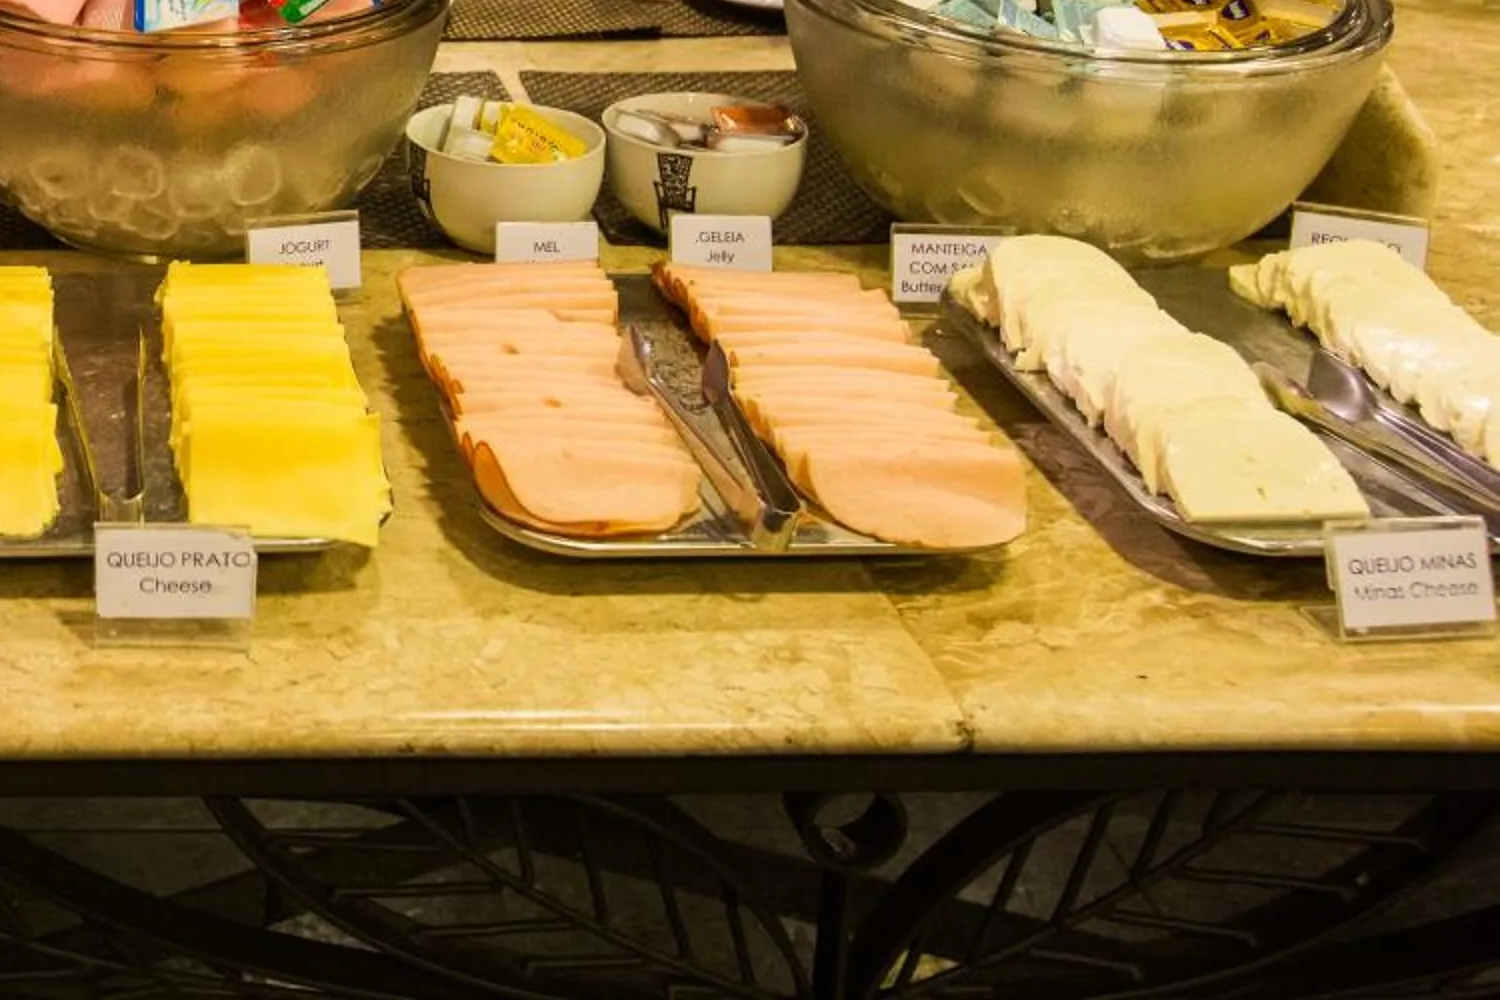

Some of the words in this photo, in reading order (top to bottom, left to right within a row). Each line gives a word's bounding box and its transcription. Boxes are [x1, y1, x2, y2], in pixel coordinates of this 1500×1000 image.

[698, 231, 745, 243] GELEIA
[533, 241, 560, 253] MEL
[911, 243, 987, 256] MANTEIGA
[909, 261, 947, 275] COM
[106, 551, 176, 568] QUEIJO
[181, 551, 250, 568] PRATO
[1348, 555, 1414, 575] QUEIJO
[1420, 552, 1477, 570] MINAS
[139, 577, 212, 594] Cheese
[1410, 581, 1478, 599] Cheese
